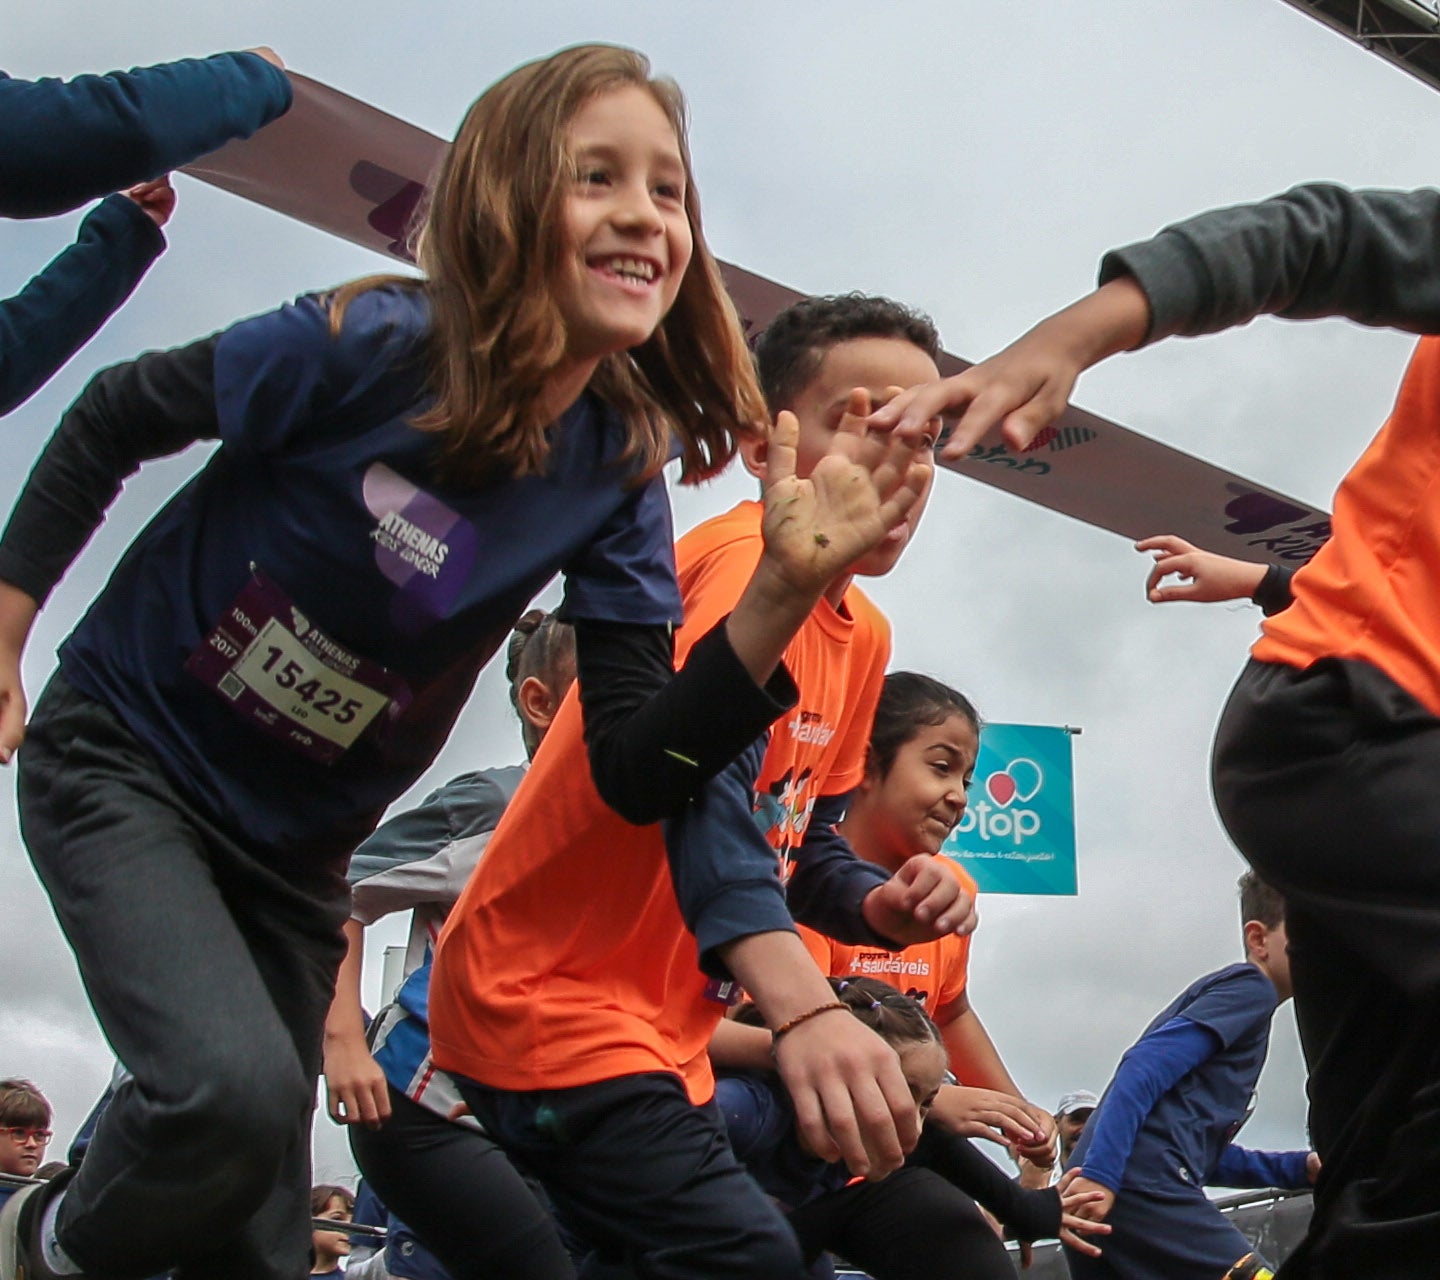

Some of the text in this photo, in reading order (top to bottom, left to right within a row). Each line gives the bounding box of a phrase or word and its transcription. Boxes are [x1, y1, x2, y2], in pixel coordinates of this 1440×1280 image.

[379, 511, 449, 564] ATHENAS
[231, 607, 258, 635] 100m
[210, 634, 238, 659] 2017
[309, 629, 360, 670] ATHENAS
[262, 645, 363, 725] 15425
[290, 705, 309, 719] LEO
[950, 800, 1041, 845] ptop
